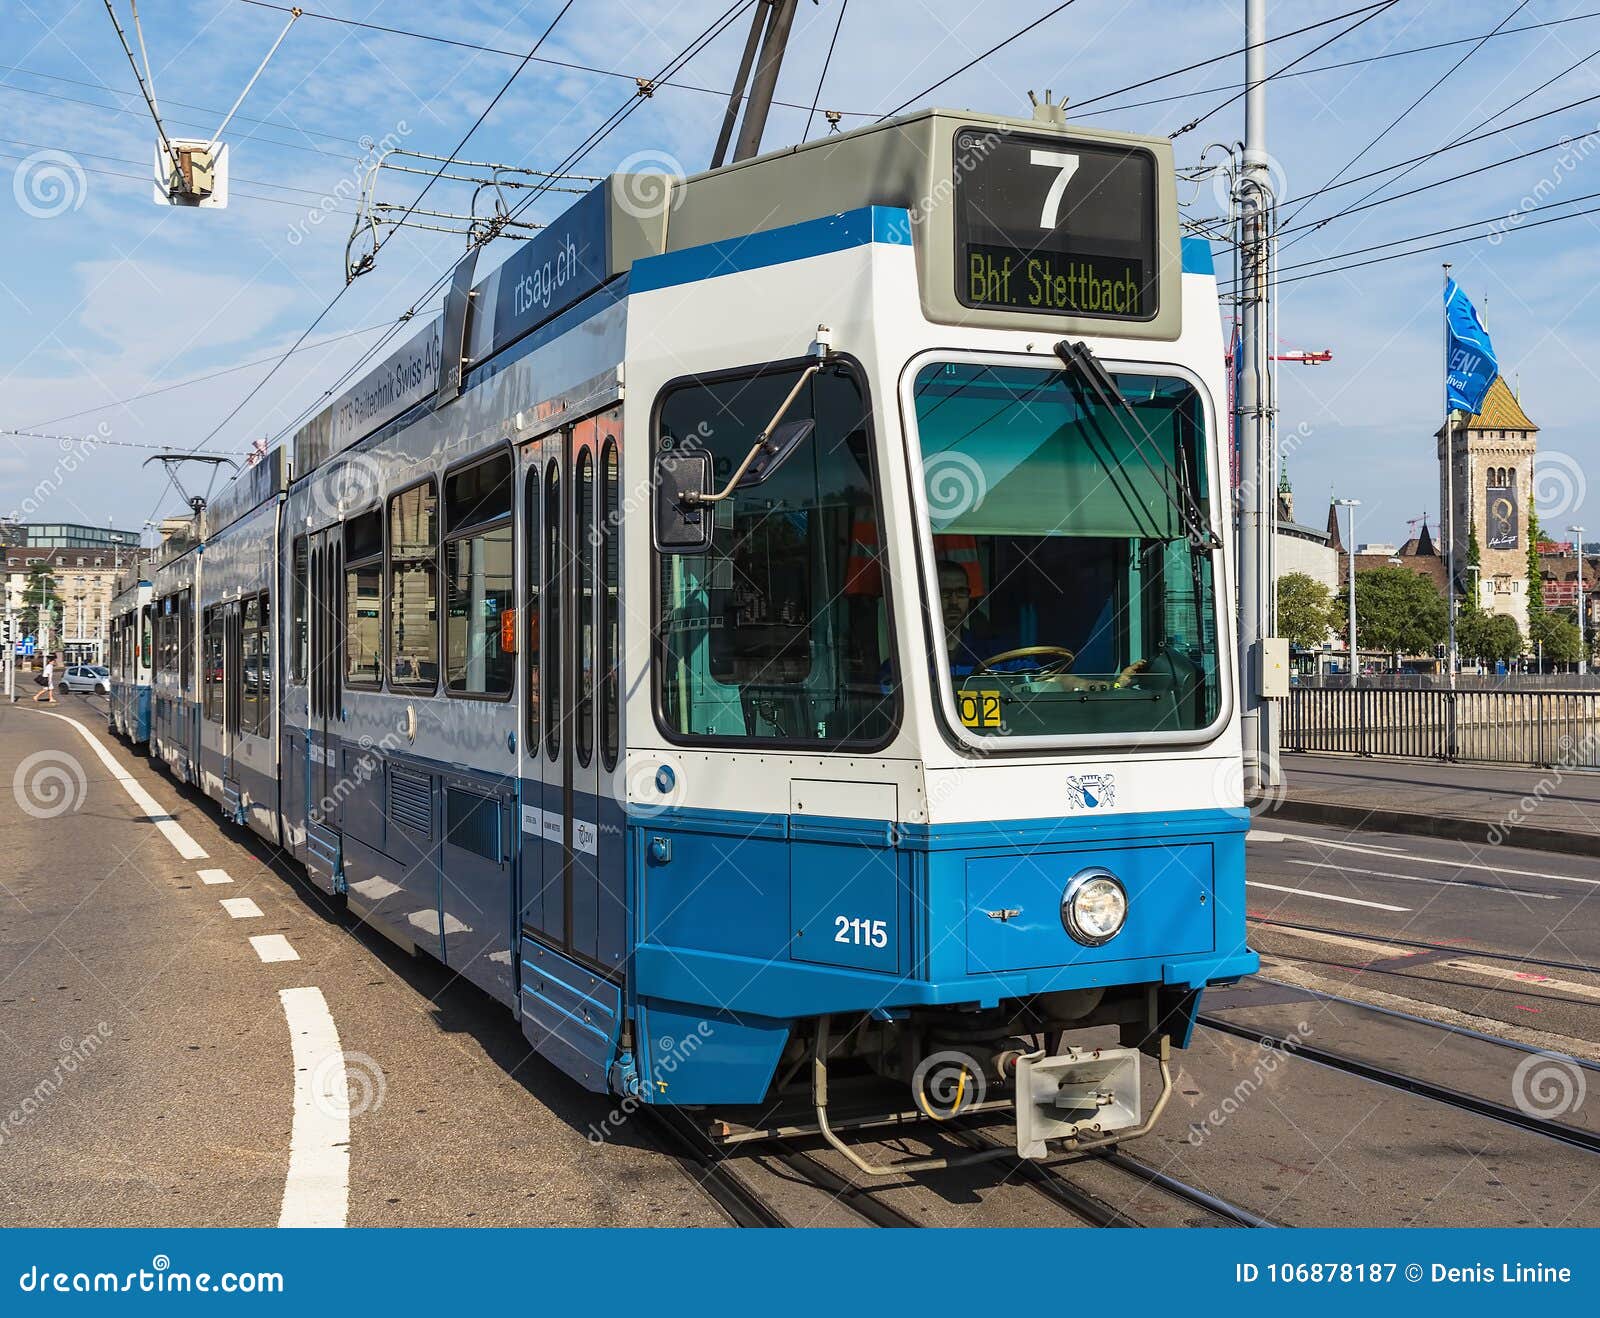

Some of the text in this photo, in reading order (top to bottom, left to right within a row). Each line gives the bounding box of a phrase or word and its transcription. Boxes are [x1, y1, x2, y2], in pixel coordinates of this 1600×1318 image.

[1030, 150, 1080, 230] 7
[514, 232, 576, 317] rtsag.ch
[970, 253, 1138, 313] Bhf. Stettbach
[396, 356, 422, 398] Swiss
[424, 335, 440, 379] AG
[1449, 347, 1481, 377] EN!
[834, 915, 888, 948] 2115
